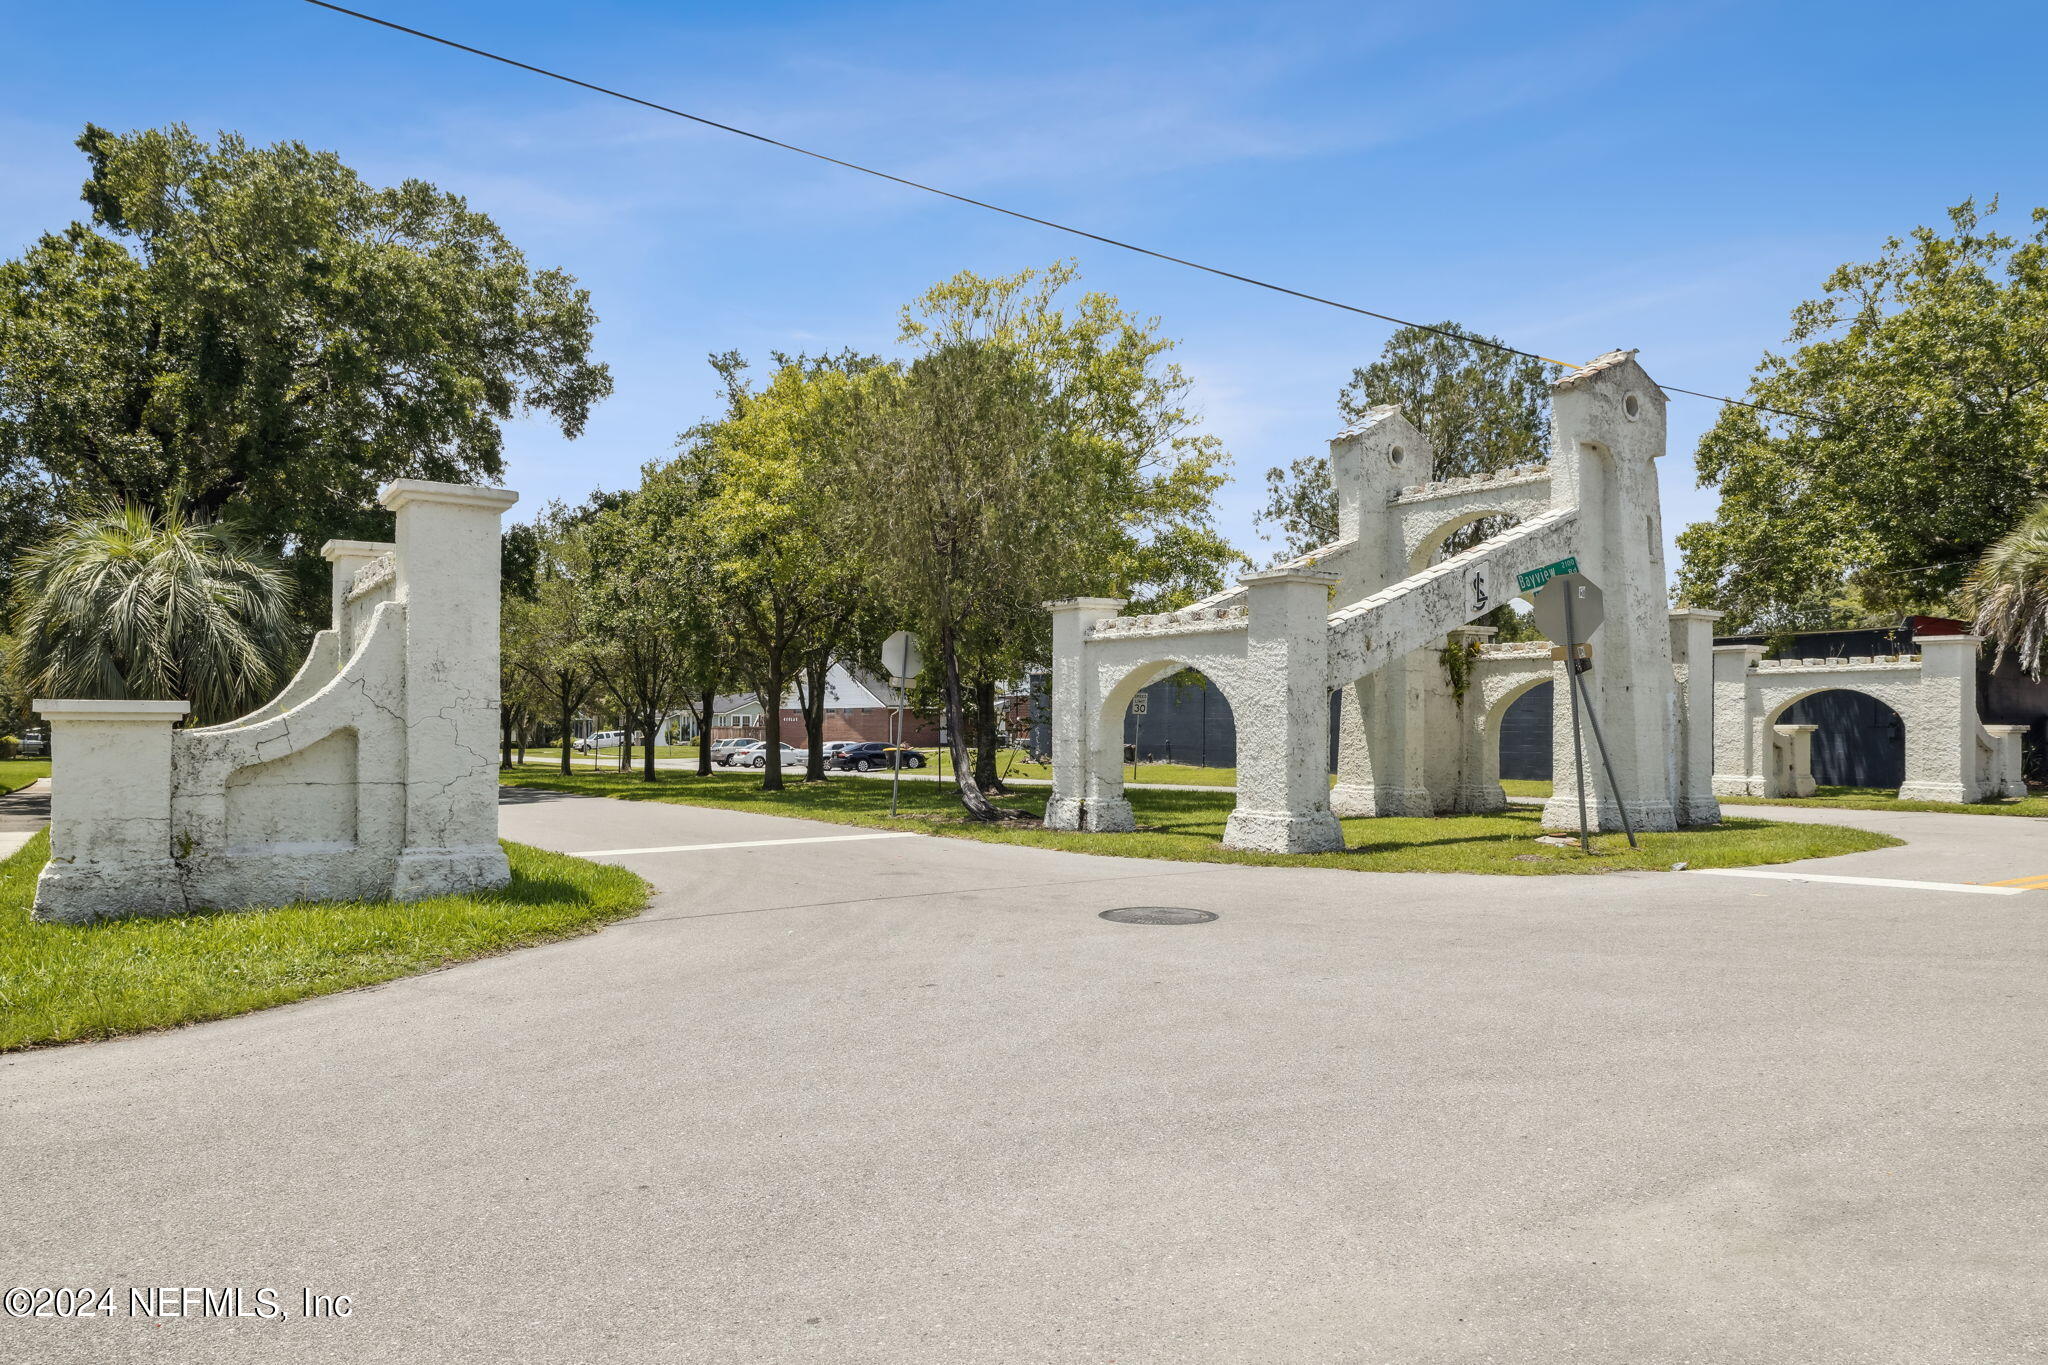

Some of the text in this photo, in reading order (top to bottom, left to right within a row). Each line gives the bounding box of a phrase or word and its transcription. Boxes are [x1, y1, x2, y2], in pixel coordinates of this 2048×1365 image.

[1561, 559, 1575, 569] 2100
[1518, 567, 1556, 589] Bayview
[1134, 704, 1146, 712] 30
